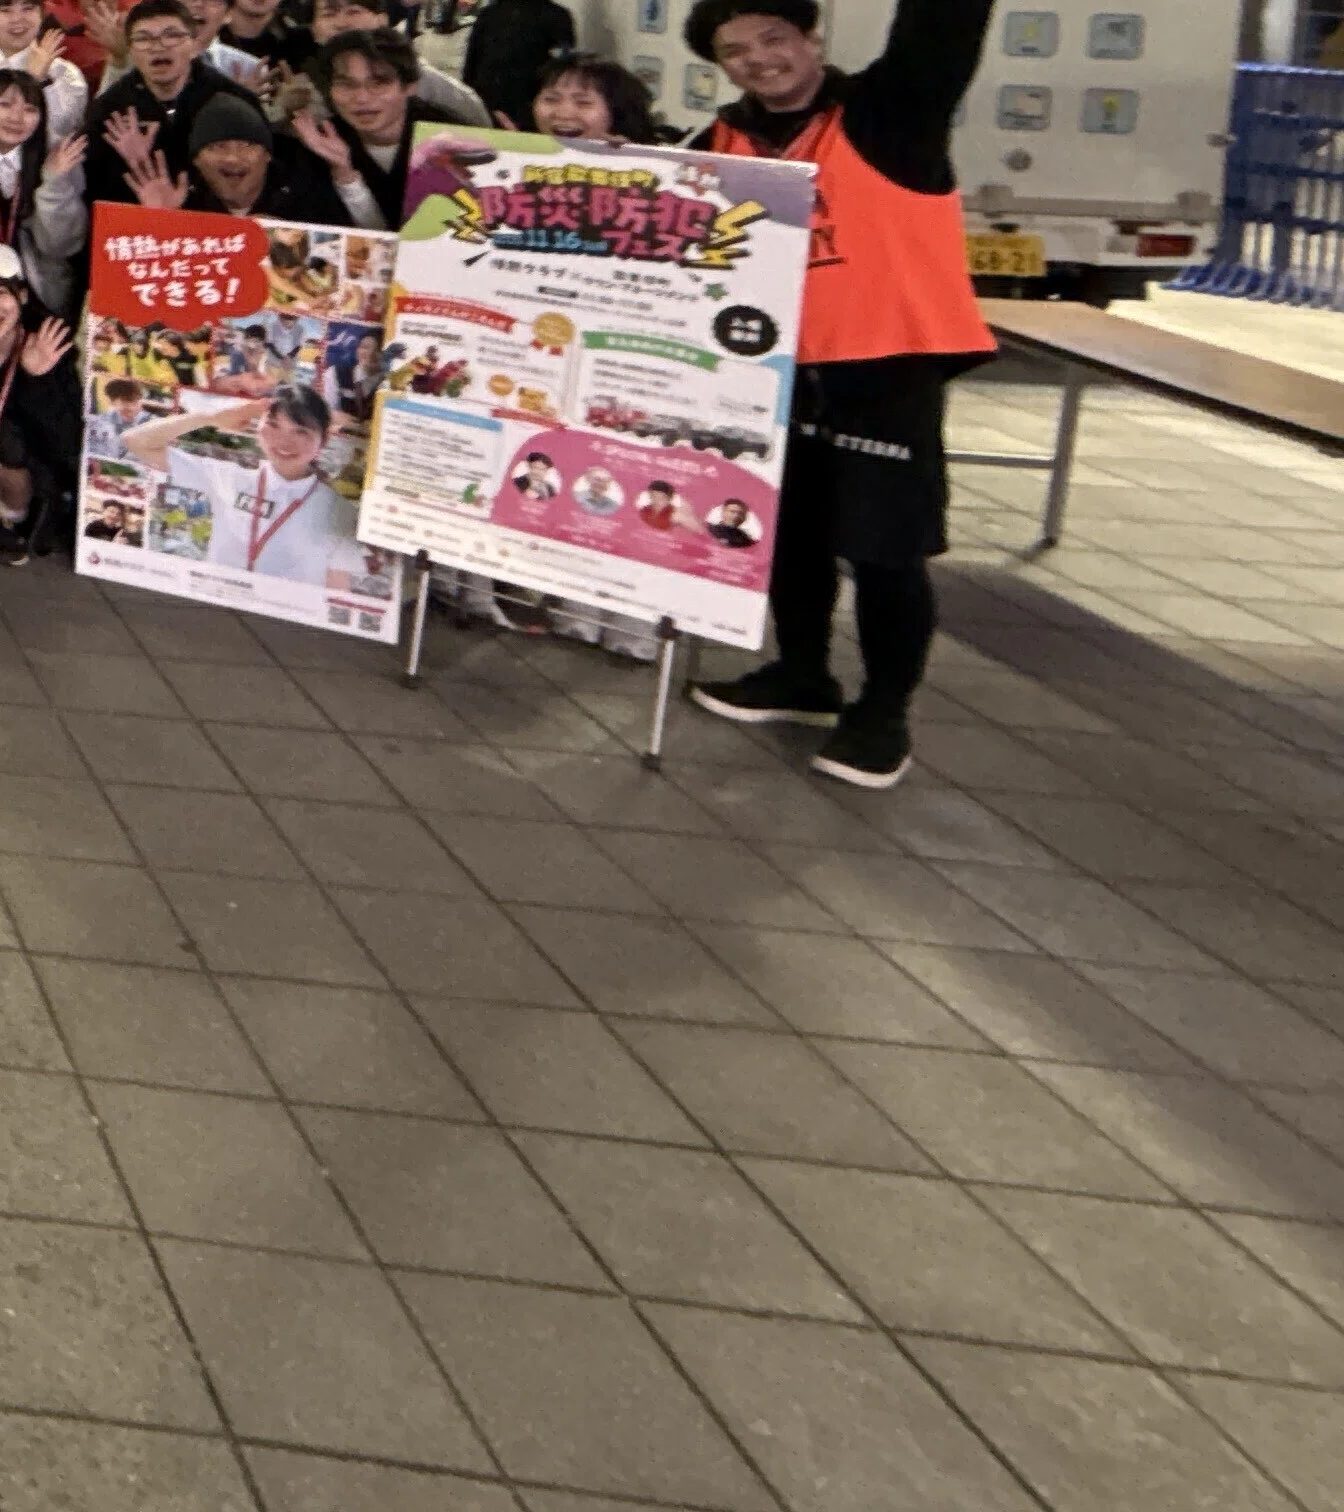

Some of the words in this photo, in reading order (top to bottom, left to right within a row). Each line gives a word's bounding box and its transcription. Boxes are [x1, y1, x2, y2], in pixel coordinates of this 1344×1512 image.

[479, 182, 718, 241] 防災防犯
[104, 232, 247, 264] 情熱があれば
[602, 229, 688, 260] フェス
[127, 258, 230, 280] なんだって
[132, 278, 243, 308] できる!
